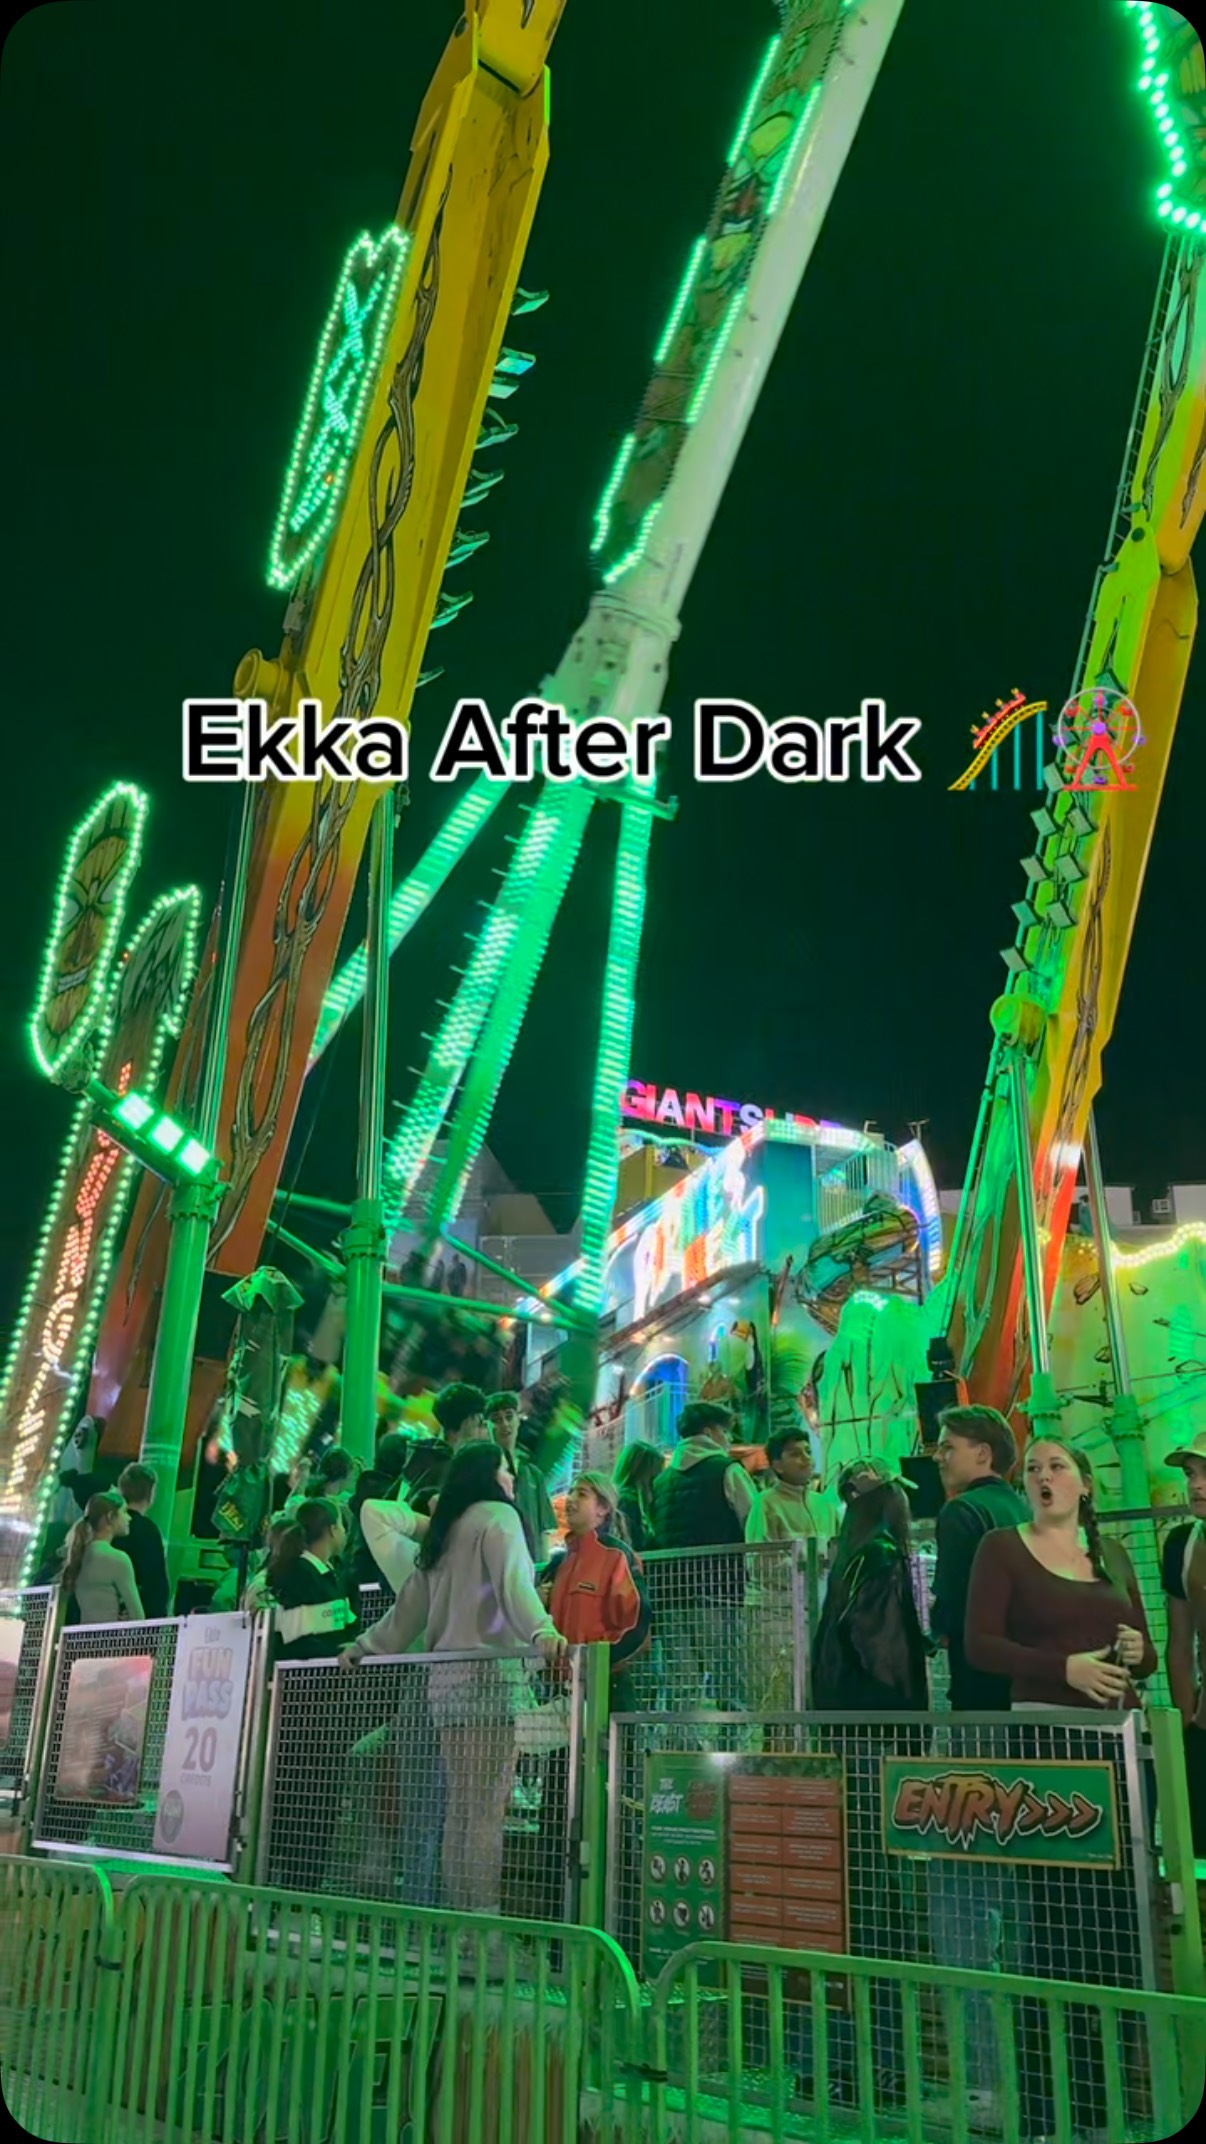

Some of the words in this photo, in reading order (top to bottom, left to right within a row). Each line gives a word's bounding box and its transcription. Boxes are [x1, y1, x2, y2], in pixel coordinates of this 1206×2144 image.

[188, 1646, 233, 1680] FUN
[181, 1680, 234, 1720] PASS
[182, 1726, 217, 1772] 20
[894, 1771, 1030, 1847] ENTRY
